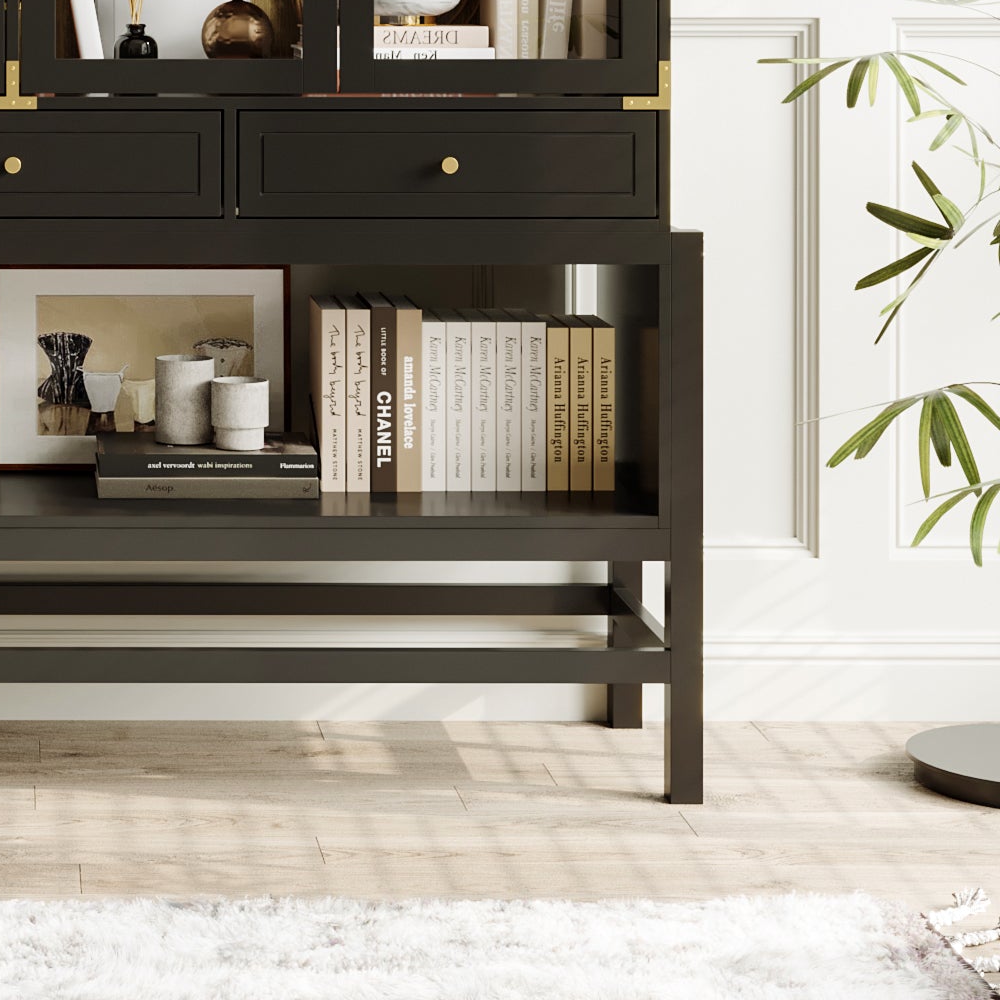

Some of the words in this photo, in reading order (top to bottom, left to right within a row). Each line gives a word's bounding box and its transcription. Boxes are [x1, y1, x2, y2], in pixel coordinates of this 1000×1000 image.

[328, 325, 341, 348] The
[353, 325, 366, 348] The
[430, 336, 441, 362] Karen
[455, 336, 466, 362] Karen
[480, 336, 491, 362] Karen
[505, 336, 517, 362] Karen
[530, 336, 542, 362] Karen
[328, 351, 344, 375] body
[353, 351, 369, 375] body
[380, 367, 387, 376] OF
[403, 356, 413, 400] amanda
[554, 356, 566, 400] Arianna
[577, 356, 589, 400] Arianna
[600, 356, 612, 400] Arianna
[426, 364, 441, 412] McCartney
[451, 364, 466, 412] McCartney
[476, 364, 491, 412] McCartney
[502, 364, 517, 412] McCartney
[527, 364, 542, 412] McCartney
[376, 391, 392, 468] CHANEL
[403, 403, 416, 449] lovelace
[551, 403, 566, 463] Huffington
[574, 403, 589, 463] Huffington
[597, 403, 612, 463] Huffington
[162, 461, 196, 469] vervoordt
[197, 461, 213, 469] wabi
[215, 461, 253, 470] inspirations
